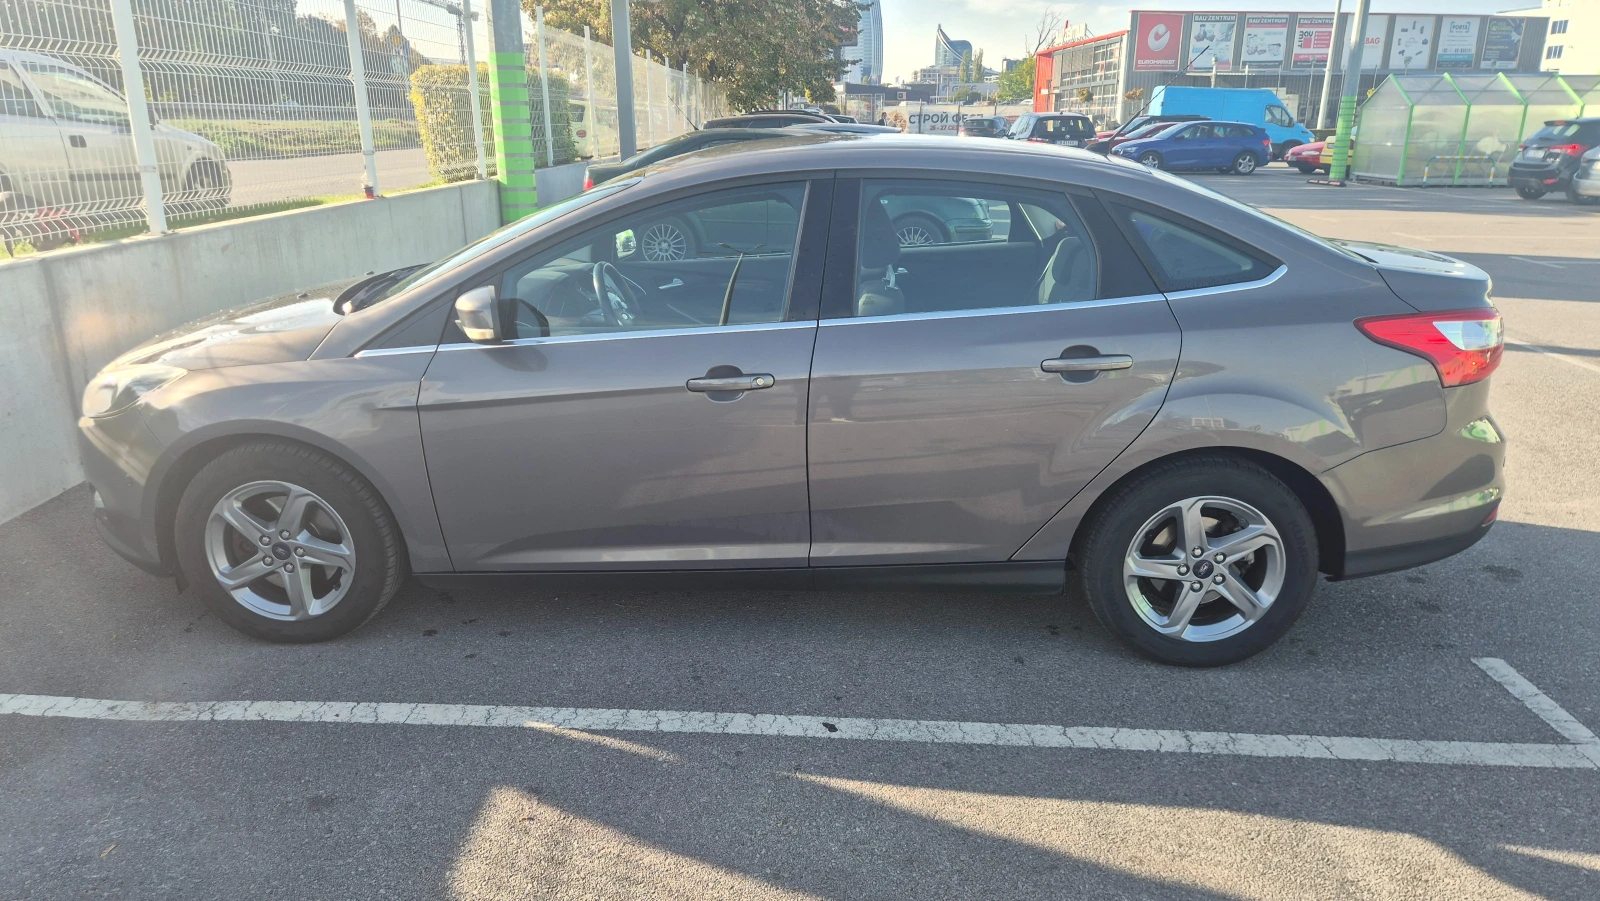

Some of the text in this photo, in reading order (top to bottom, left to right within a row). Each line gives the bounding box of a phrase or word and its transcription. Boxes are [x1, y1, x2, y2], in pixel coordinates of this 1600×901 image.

[1364, 37, 1381, 45] BAG
[908, 111, 984, 124] СТРОЙ ФЕ
